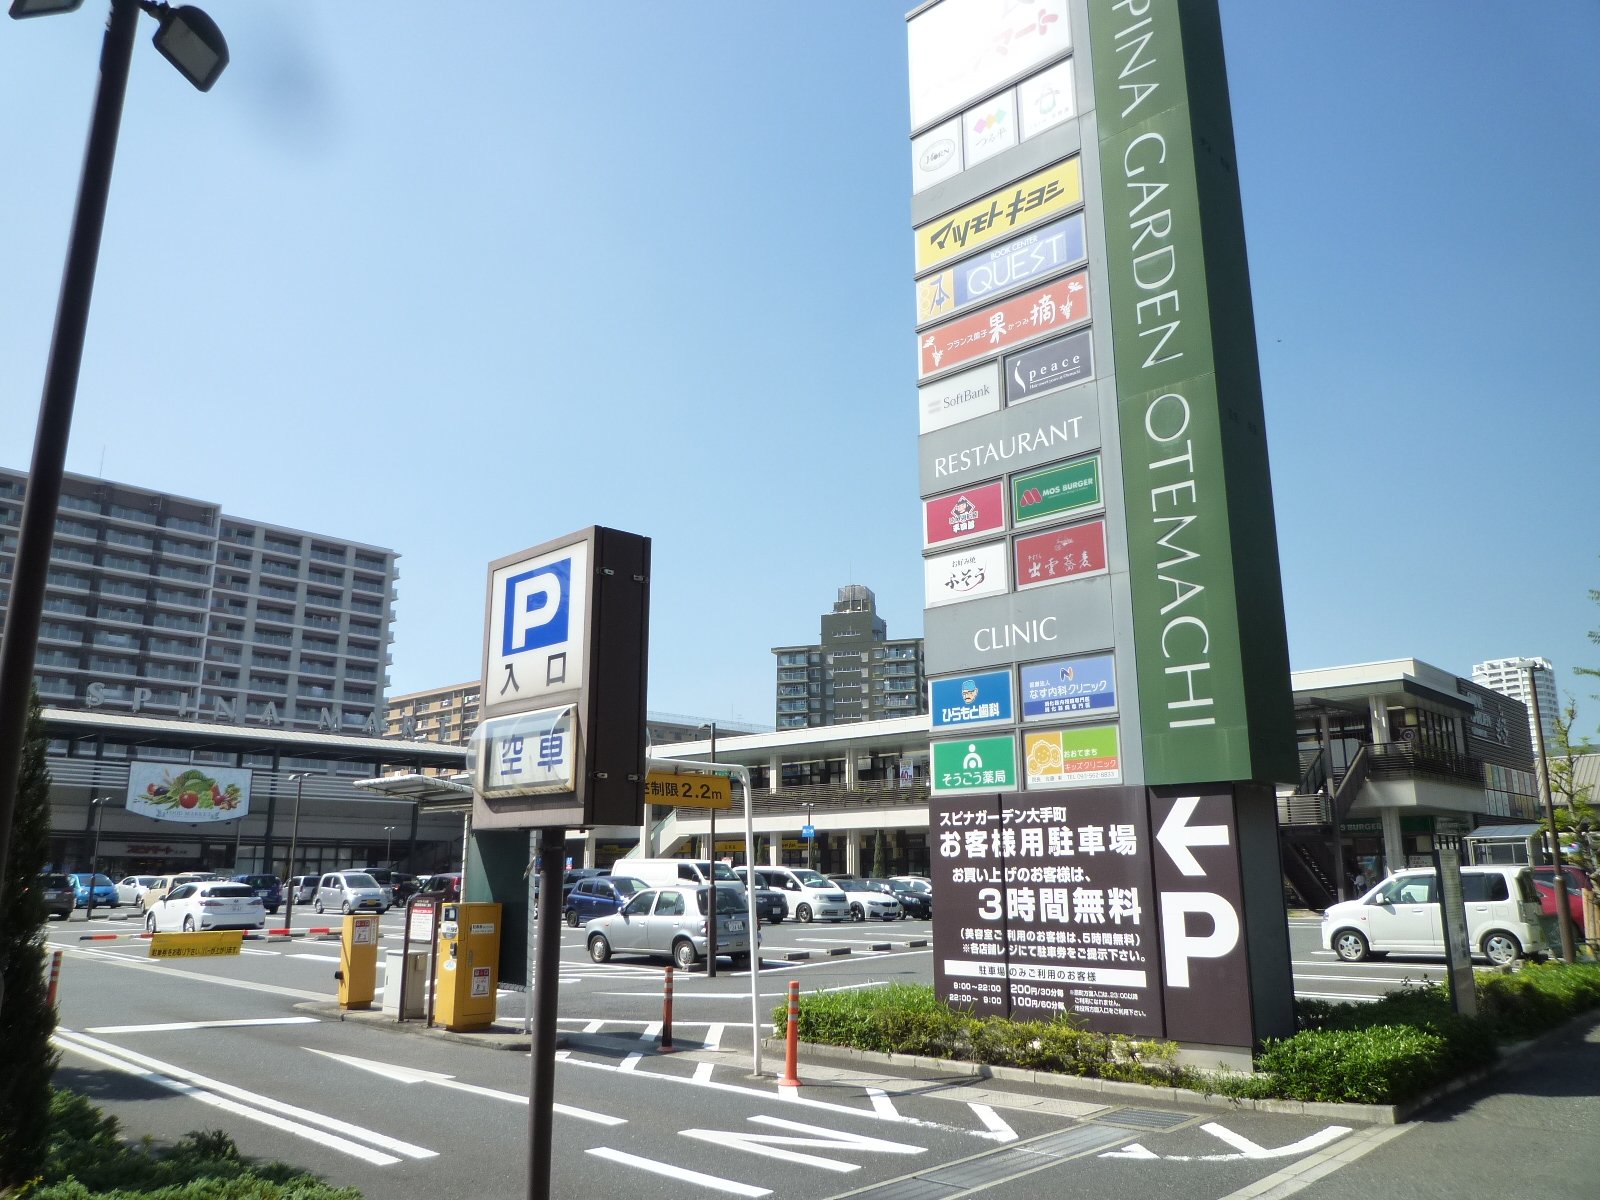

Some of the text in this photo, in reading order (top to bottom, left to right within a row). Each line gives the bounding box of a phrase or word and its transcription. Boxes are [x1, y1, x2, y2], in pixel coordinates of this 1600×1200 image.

[930, 180, 1064, 250] マツモトキヨシ
[968, 233, 1064, 295] QUEST
[991, 235, 1039, 261] BOOK CENTER
[1124, 132, 1183, 368] GARDEN
[988, 312, 1007, 344] 果
[1030, 294, 1056, 326] 摘
[1029, 355, 1080, 381] peace
[943, 385, 990, 409] SoftBank
[934, 416, 1083, 478] RESTAURANT
[1042, 486, 1060, 497] MOS
[1062, 478, 1093, 492] BURGER
[1145, 393, 1215, 728] OTEMACHI
[511, 572, 561, 650] P
[973, 616, 1057, 652] CLINIC
[500, 651, 567, 696] 入口
[1029, 680, 1107, 699] なす内科クリニック
[86, 682, 280, 727] SPINA
[942, 703, 1000, 722] ひらもと歯科
[500, 727, 564, 776] 空車
[1063, 749, 1098, 758] おおてまち
[1064, 760, 1116, 771] キッズクリニック
[942, 769, 1006, 787] そうこう薬局
[939, 806, 1067, 826] スピナガーデン大手町
[940, 824, 1137, 859] お客様用駐車場
[952, 866, 1091, 884] お買い上げのお客様は、
[978, 886, 1142, 925] 3時間無料
[1161, 891, 1239, 987] P
[979, 965, 1097, 982] 駐車場のみご利用のお客様
